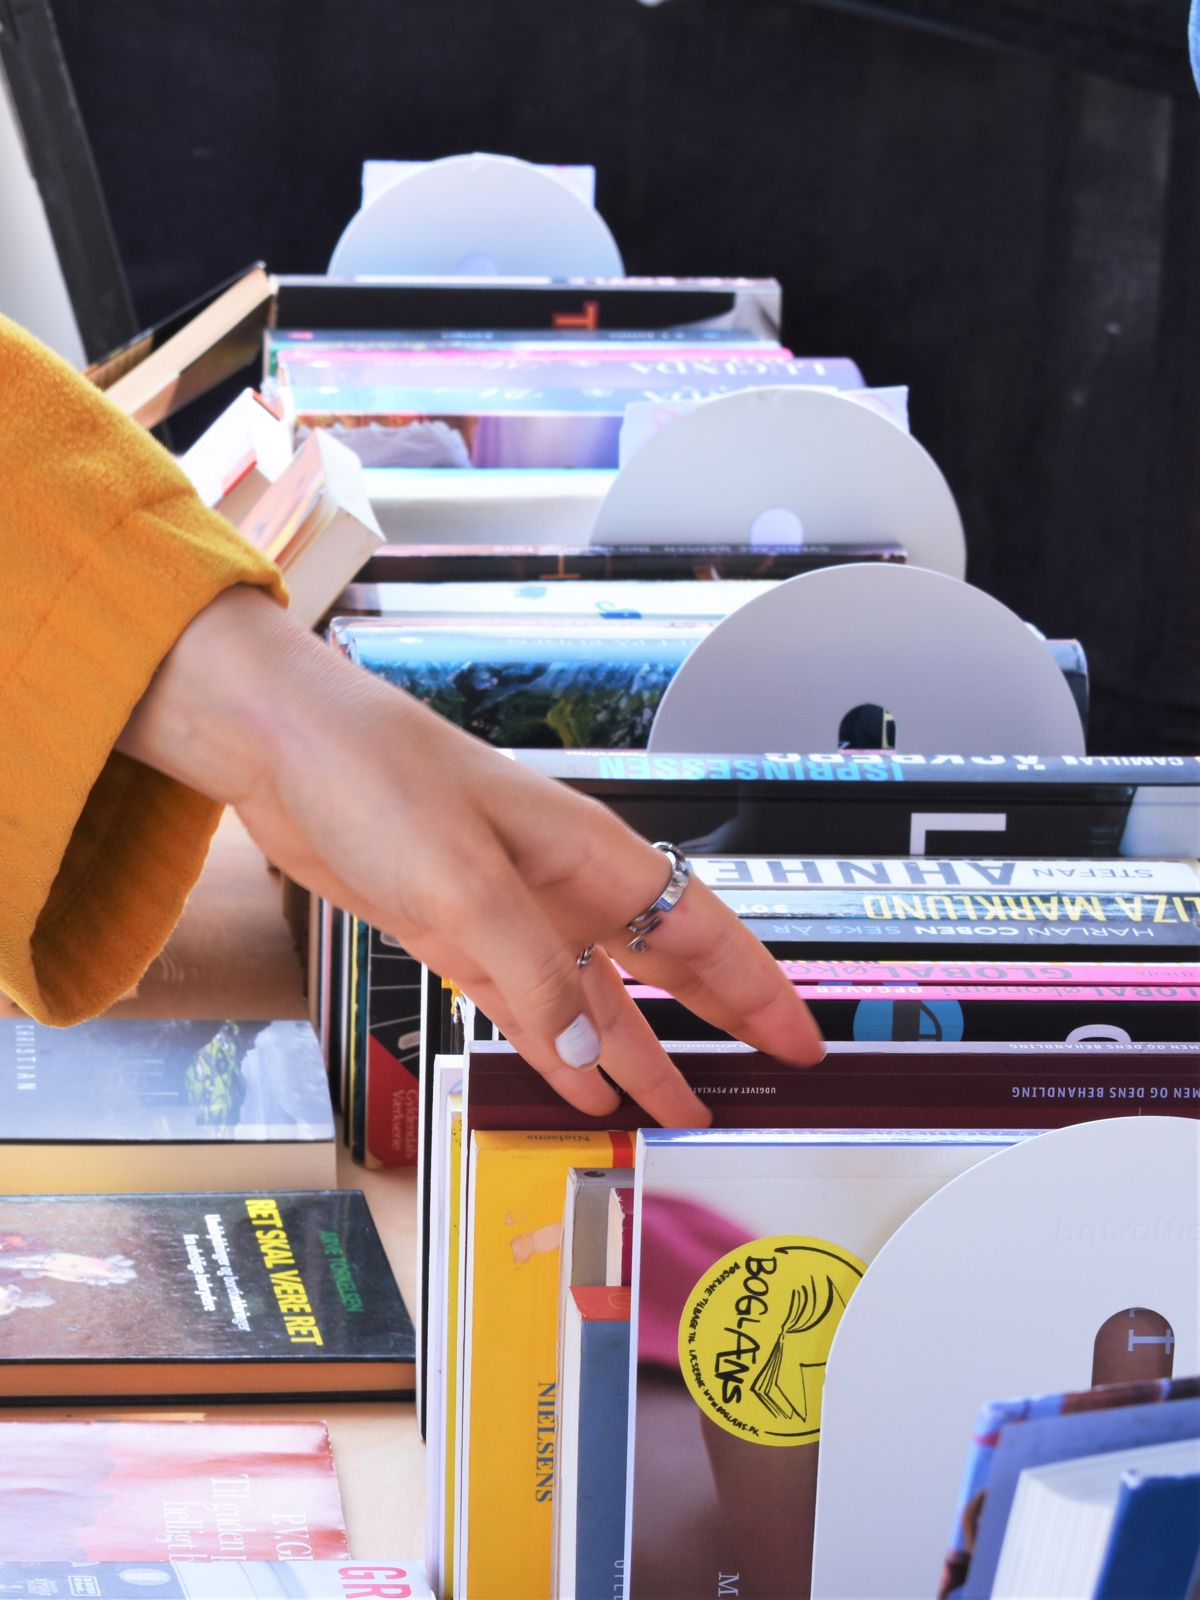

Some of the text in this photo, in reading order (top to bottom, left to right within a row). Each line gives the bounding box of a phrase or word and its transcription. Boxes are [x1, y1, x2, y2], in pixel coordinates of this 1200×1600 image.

[687, 860, 1155, 886] STEFAN AHNHE
[862, 895, 1109, 923] MARKLUND
[772, 925, 1155, 938] HARLAN COBEN SEKS ÅR
[1011, 1086, 1200, 1099] MEN OG DENS BEHANDLING
[244, 1199, 325, 1346] RET SKAL VÆRE RET
[688, 1297, 710, 1330] TILBAGE
[535, 1382, 557, 1504] NIELSENS
